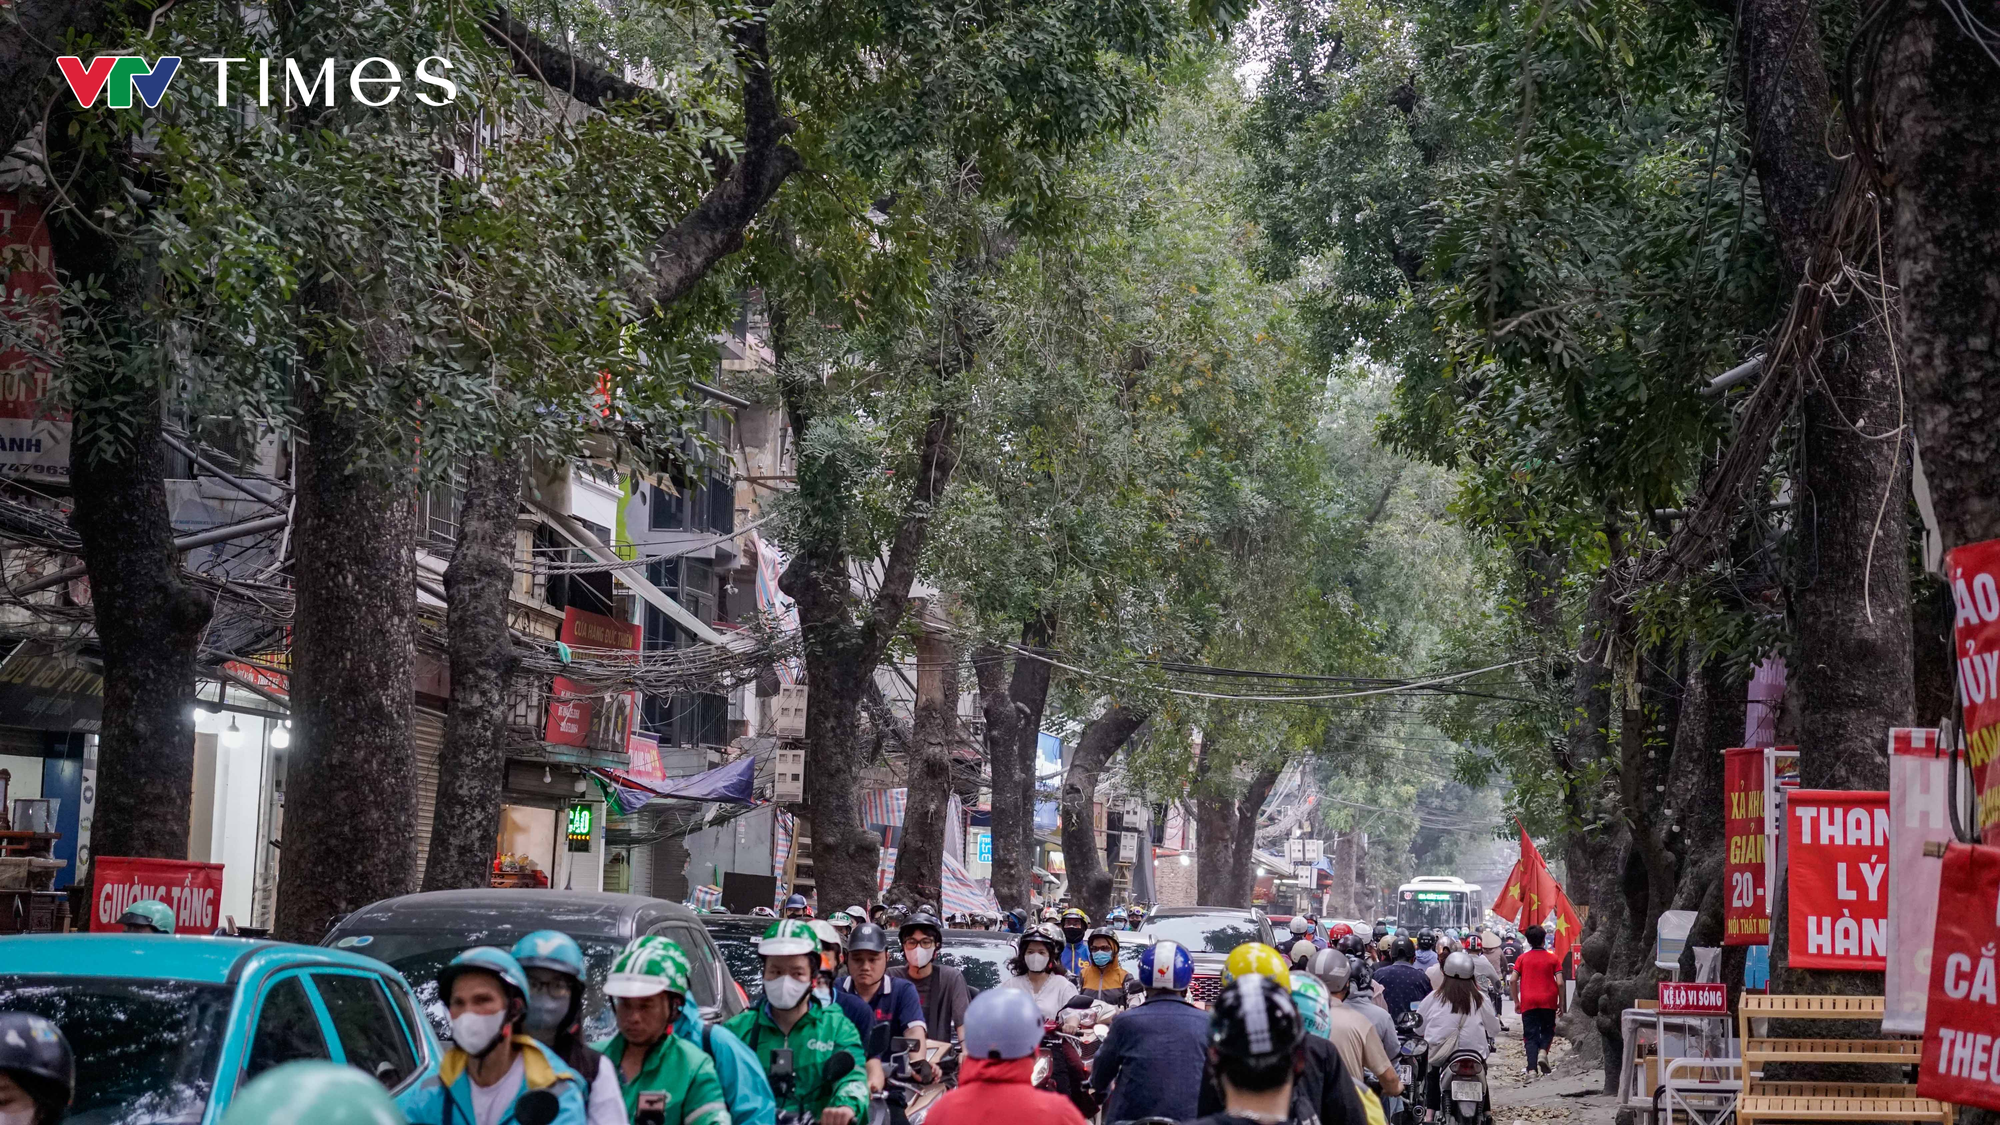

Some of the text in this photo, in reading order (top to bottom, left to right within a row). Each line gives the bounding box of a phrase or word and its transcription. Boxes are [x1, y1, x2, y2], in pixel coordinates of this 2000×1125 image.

[1731, 779, 1746, 819] XẢ
[1732, 872, 1753, 908] 20
[1837, 855, 1887, 901] LÝ
[1728, 915, 1739, 937] NỘI
[1740, 913, 1757, 934] THẤT
[1675, 986, 1686, 1005] LÒ
[1687, 990, 1697, 1005] VI
[1698, 986, 1722, 1006] SÓNG
